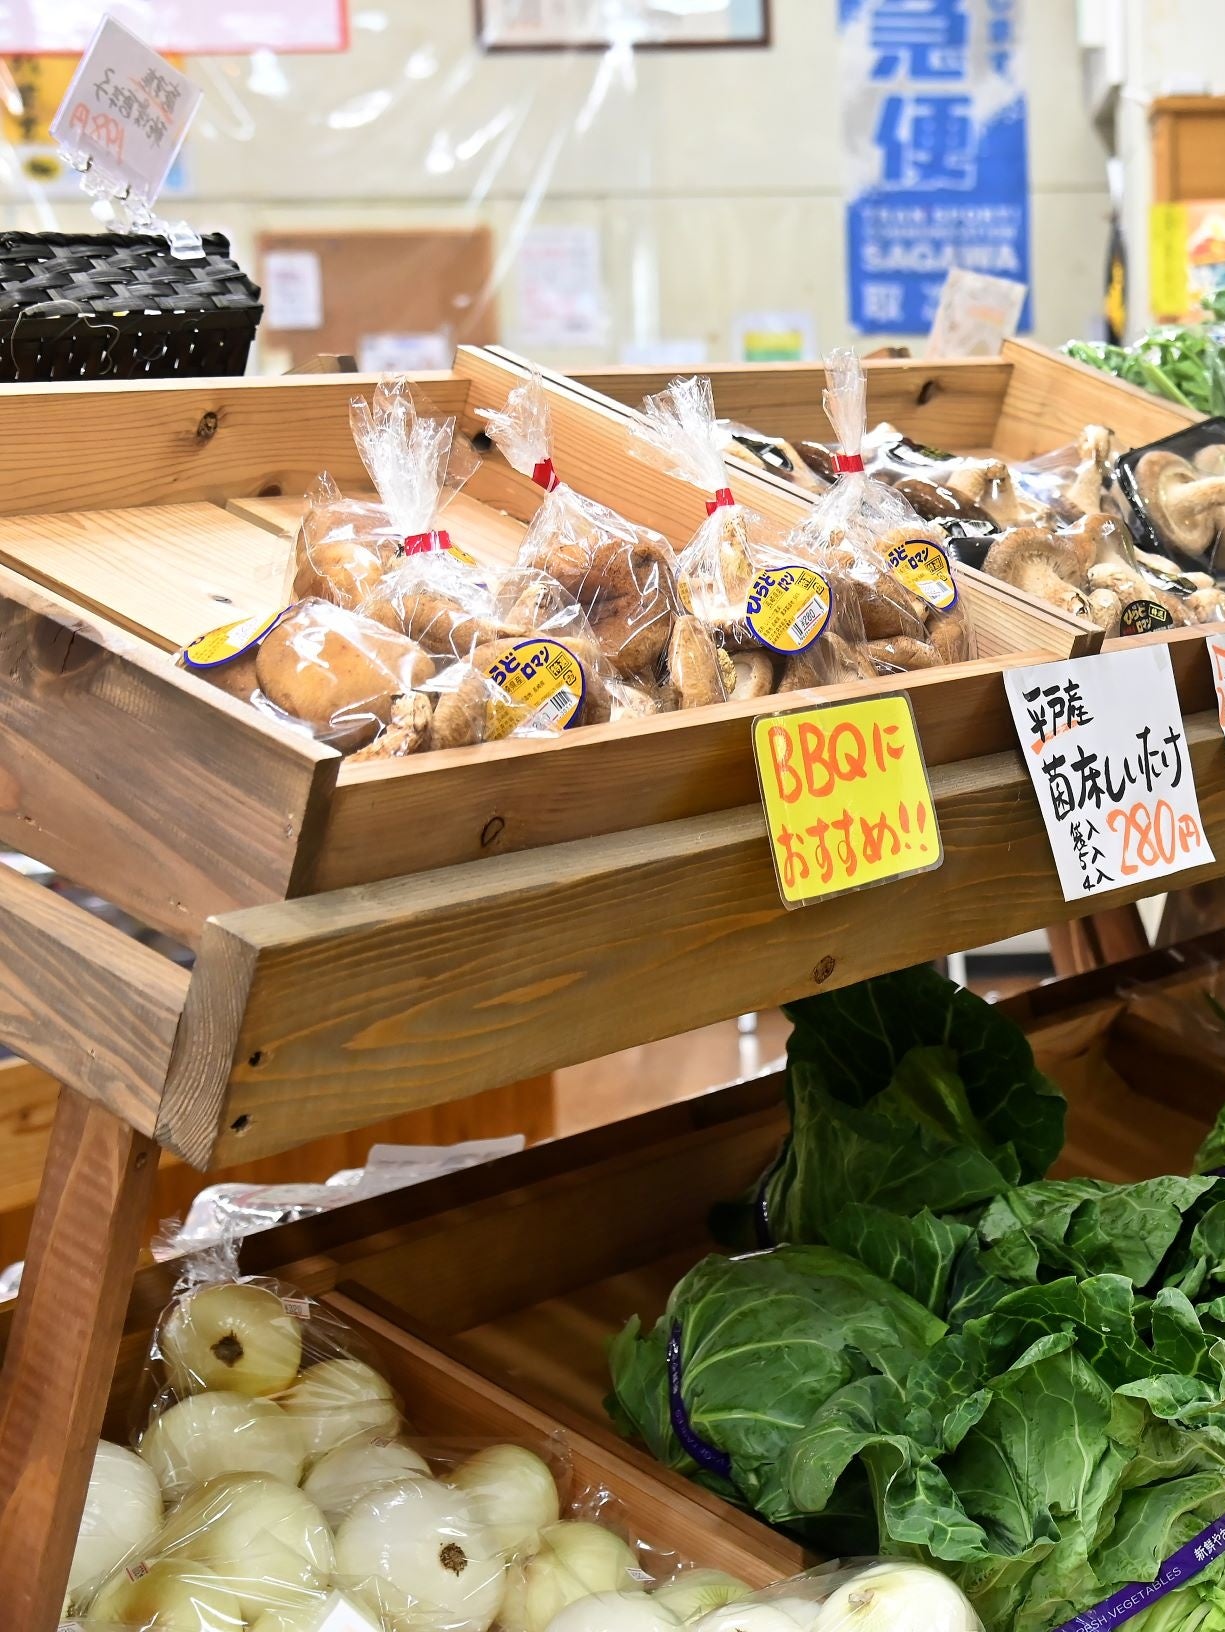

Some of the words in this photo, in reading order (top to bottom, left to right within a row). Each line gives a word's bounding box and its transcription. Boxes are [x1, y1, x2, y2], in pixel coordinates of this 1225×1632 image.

[520, 646, 550, 681] ロマン
[1022, 678, 1094, 744] 平戸産
[768, 721, 906, 804] BBQに
[1041, 725, 1182, 822] 菌床しいたけ
[1106, 799, 1201, 876] 280円
[1107, 1566, 1183, 1620] VEGETABLES
